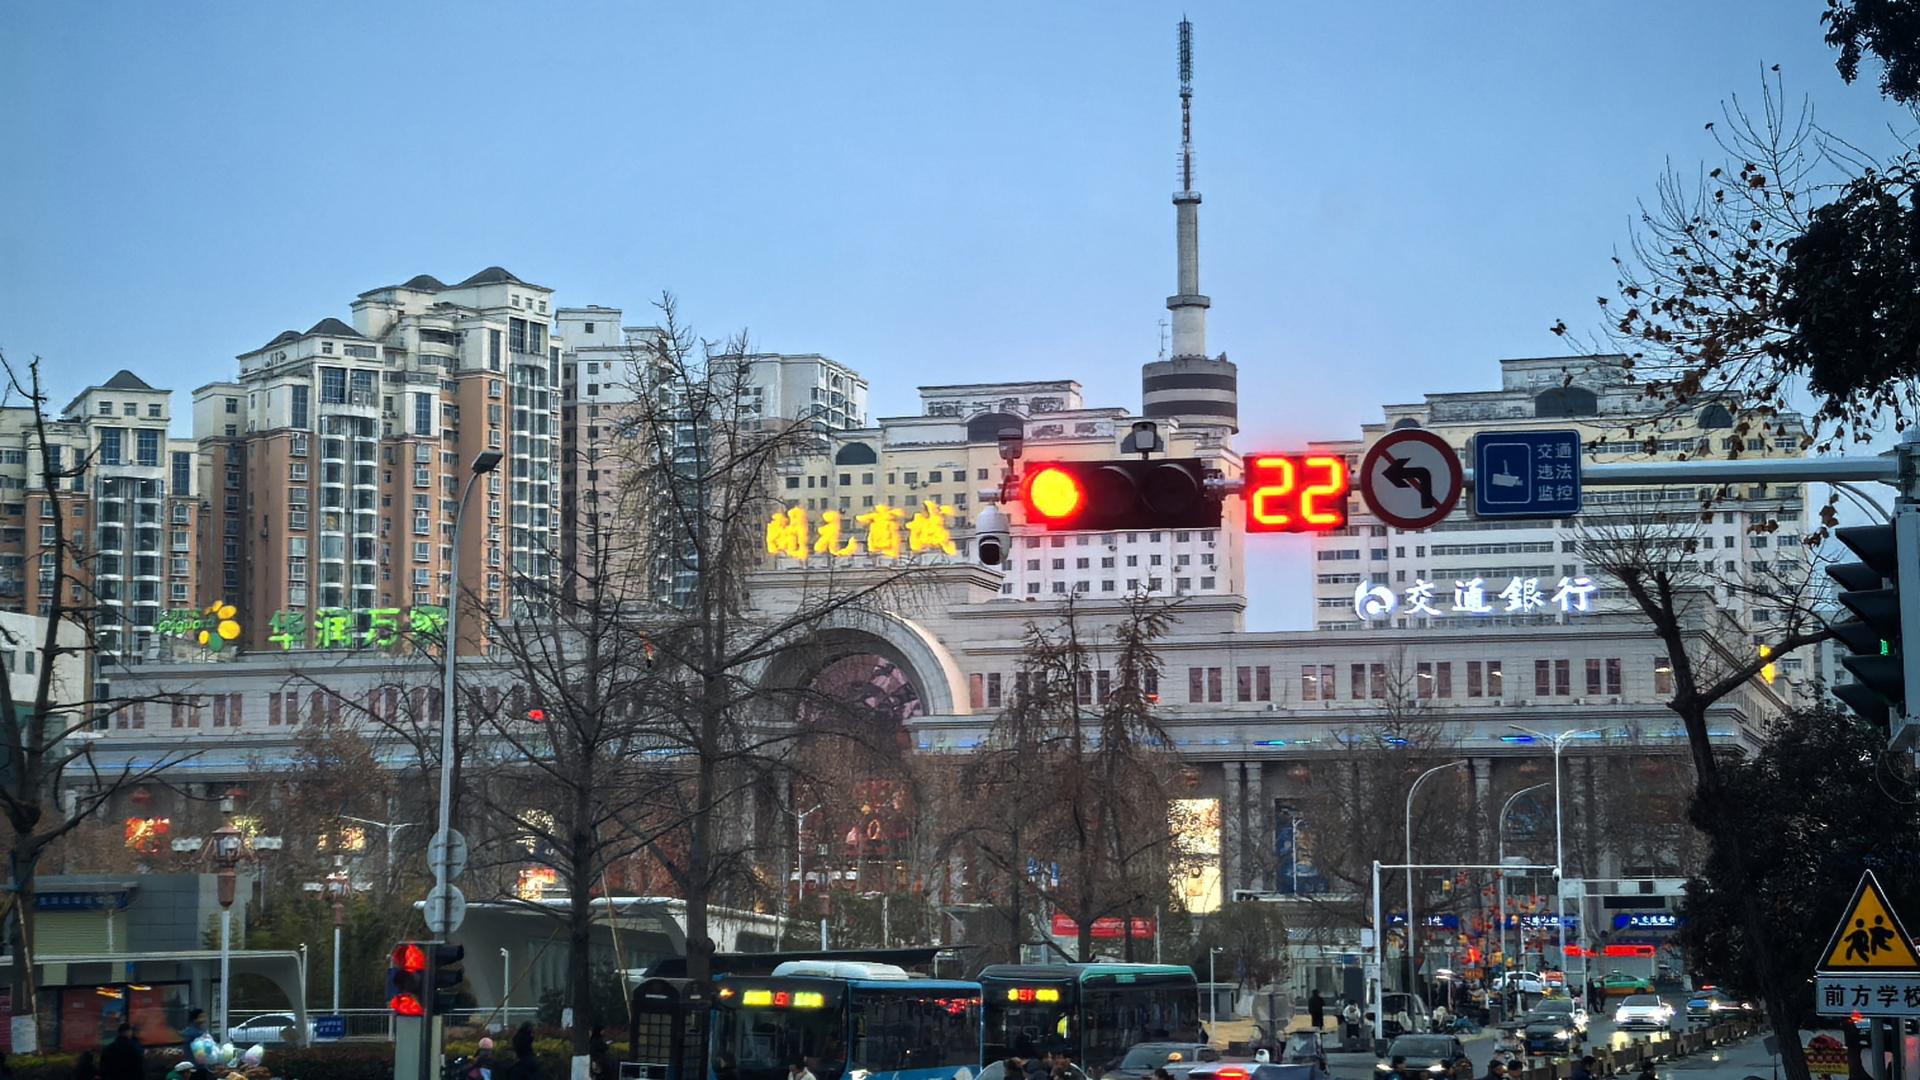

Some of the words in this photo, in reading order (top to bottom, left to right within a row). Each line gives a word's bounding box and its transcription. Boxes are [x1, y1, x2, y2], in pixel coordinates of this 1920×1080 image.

[1537, 443, 1572, 459] 交通
[1537, 464, 1572, 479] 违法
[1253, 457, 1341, 524] 22
[1537, 485, 1573, 501] 监控
[1823, 984, 1920, 1008] 前方学校
